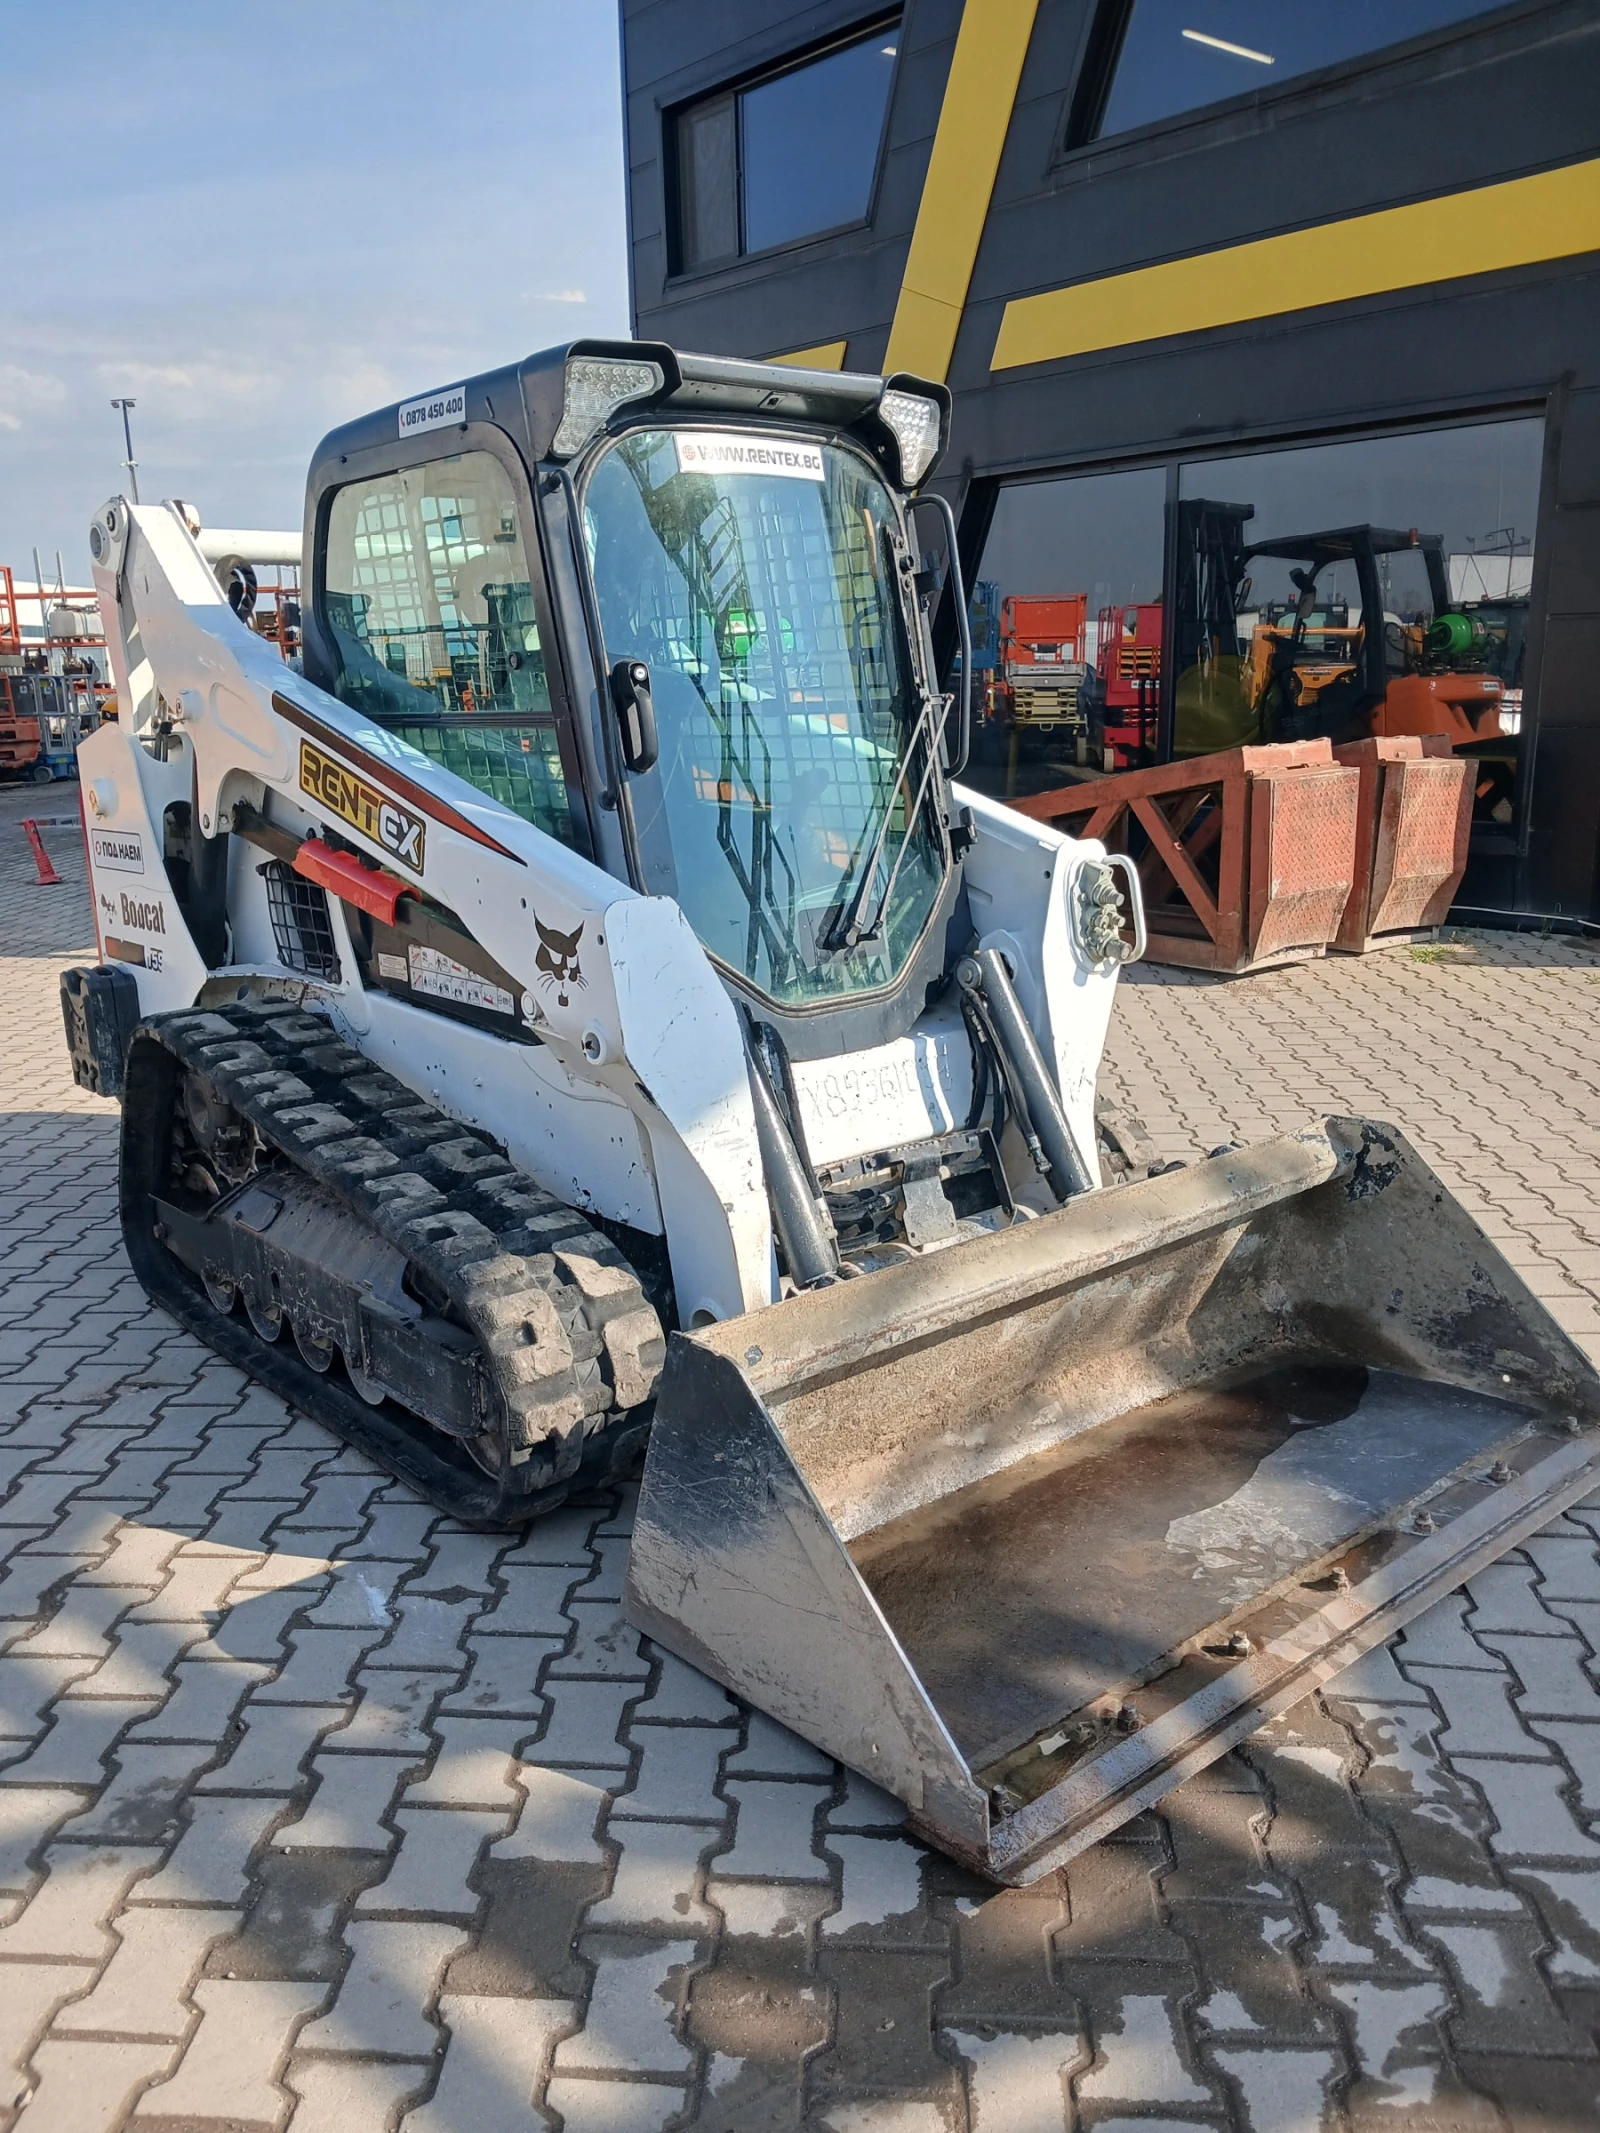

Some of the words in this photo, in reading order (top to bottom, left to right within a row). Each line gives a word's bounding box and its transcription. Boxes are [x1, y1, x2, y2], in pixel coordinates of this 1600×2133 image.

[406, 407, 427, 426] 0878
[428, 402, 445, 420] 450
[446, 396, 463, 415] 400
[697, 445, 821, 470] WWW.RENTEX.BG
[302, 748, 422, 866] RENTEX
[102, 841, 119, 858] ПОД
[119, 843, 142, 861] НАЕМ
